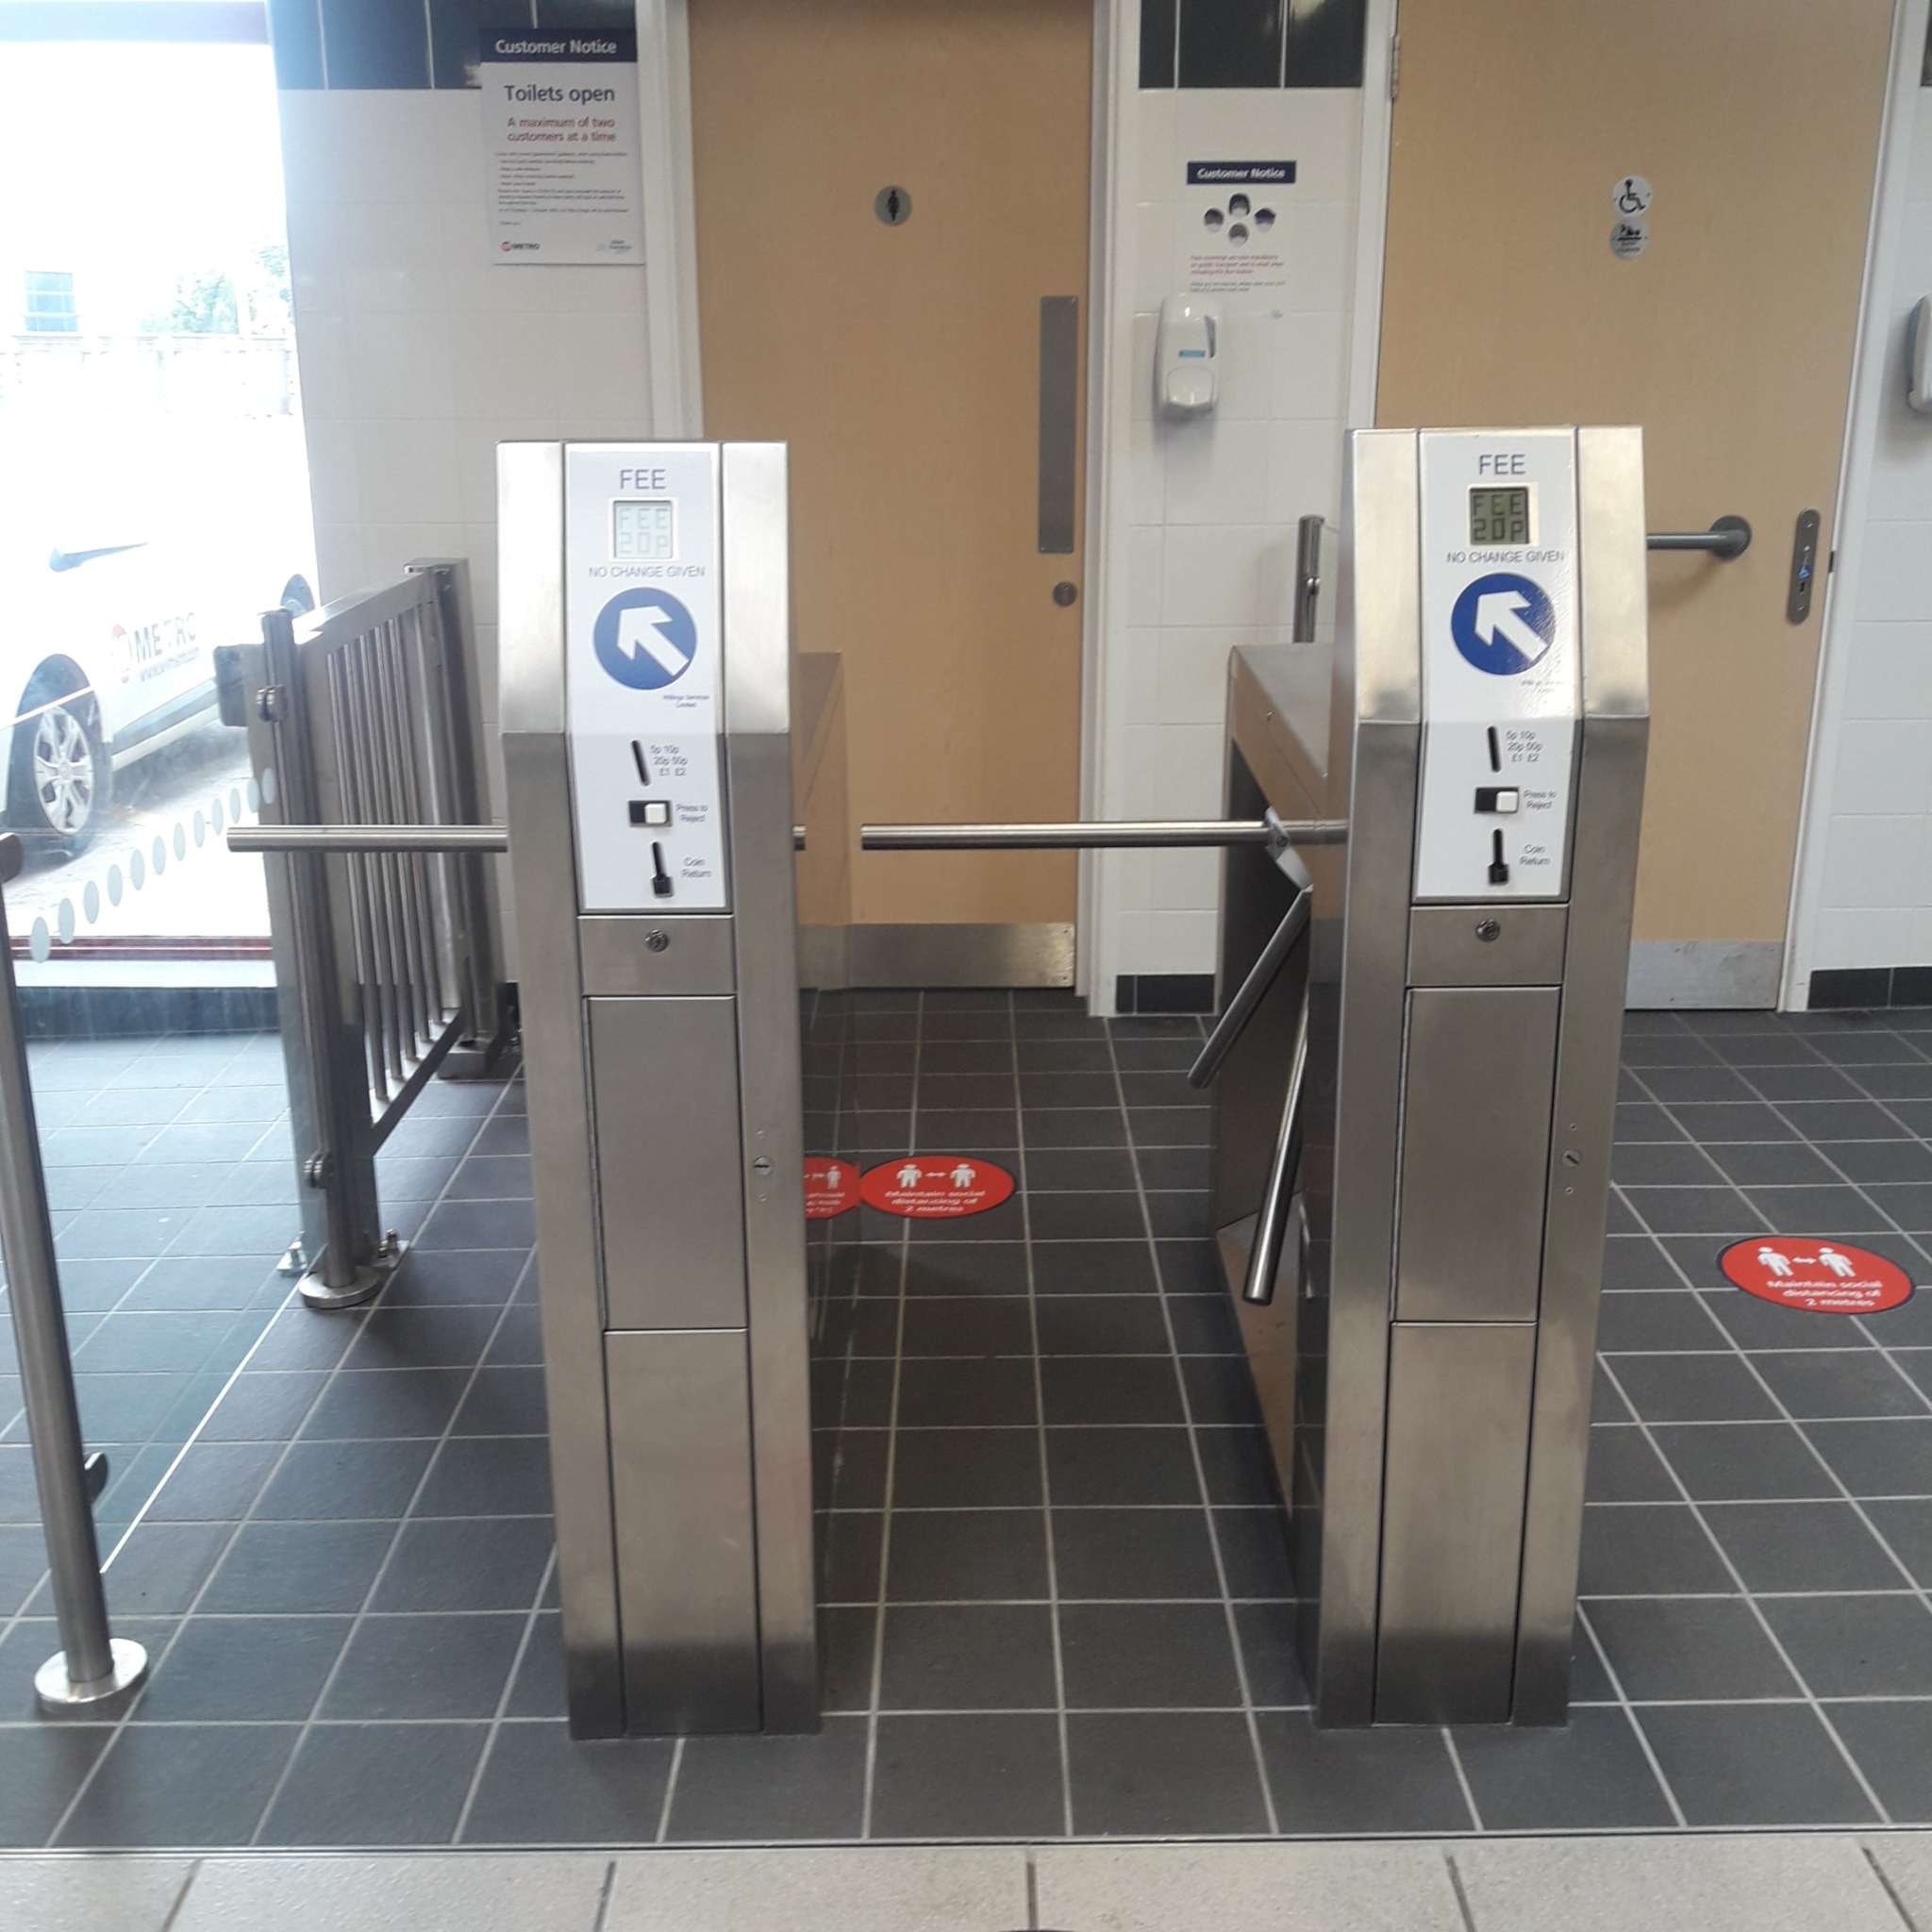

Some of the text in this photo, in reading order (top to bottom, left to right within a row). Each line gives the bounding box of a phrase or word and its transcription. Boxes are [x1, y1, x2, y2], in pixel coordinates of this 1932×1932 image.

[495, 39, 617, 54] Customer Notice
[504, 84, 615, 105] Toilets open
[508, 116, 615, 127] A maximum of two
[508, 132, 564, 142] customers
[567, 132, 578, 142] at
[591, 131, 616, 142] time
[1196, 167, 1286, 179] Customer Notice
[1478, 454, 1526, 475] FEE
[619, 469, 667, 490] FEE
[1473, 494, 1524, 516] FEE
[619, 508, 669, 529] FEE
[1474, 518, 1524, 542] 20P
[619, 532, 669, 557] 20P
[1446, 550, 1566, 564] NO CHANGE GIVEN
[589, 565, 706, 578] NO CHANGE GIVEN
[1520, 730, 1536, 741] 10p
[663, 745, 680, 755] 10p
[1507, 741, 1524, 752] 20p
[654, 757, 670, 766] 20p
[1511, 754, 1541, 762] £1 £2
[659, 768, 687, 776] £1 £2
[1524, 790, 1557, 799] Press to
[675, 804, 708, 812] Press to
[1526, 800, 1552, 811] Reject
[1524, 844, 1545, 854] Coin
[684, 857, 706, 866] Coin
[1520, 856, 1551, 865] Return
[681, 869, 712, 878] Return
[891, 1197, 960, 1206] distancing
